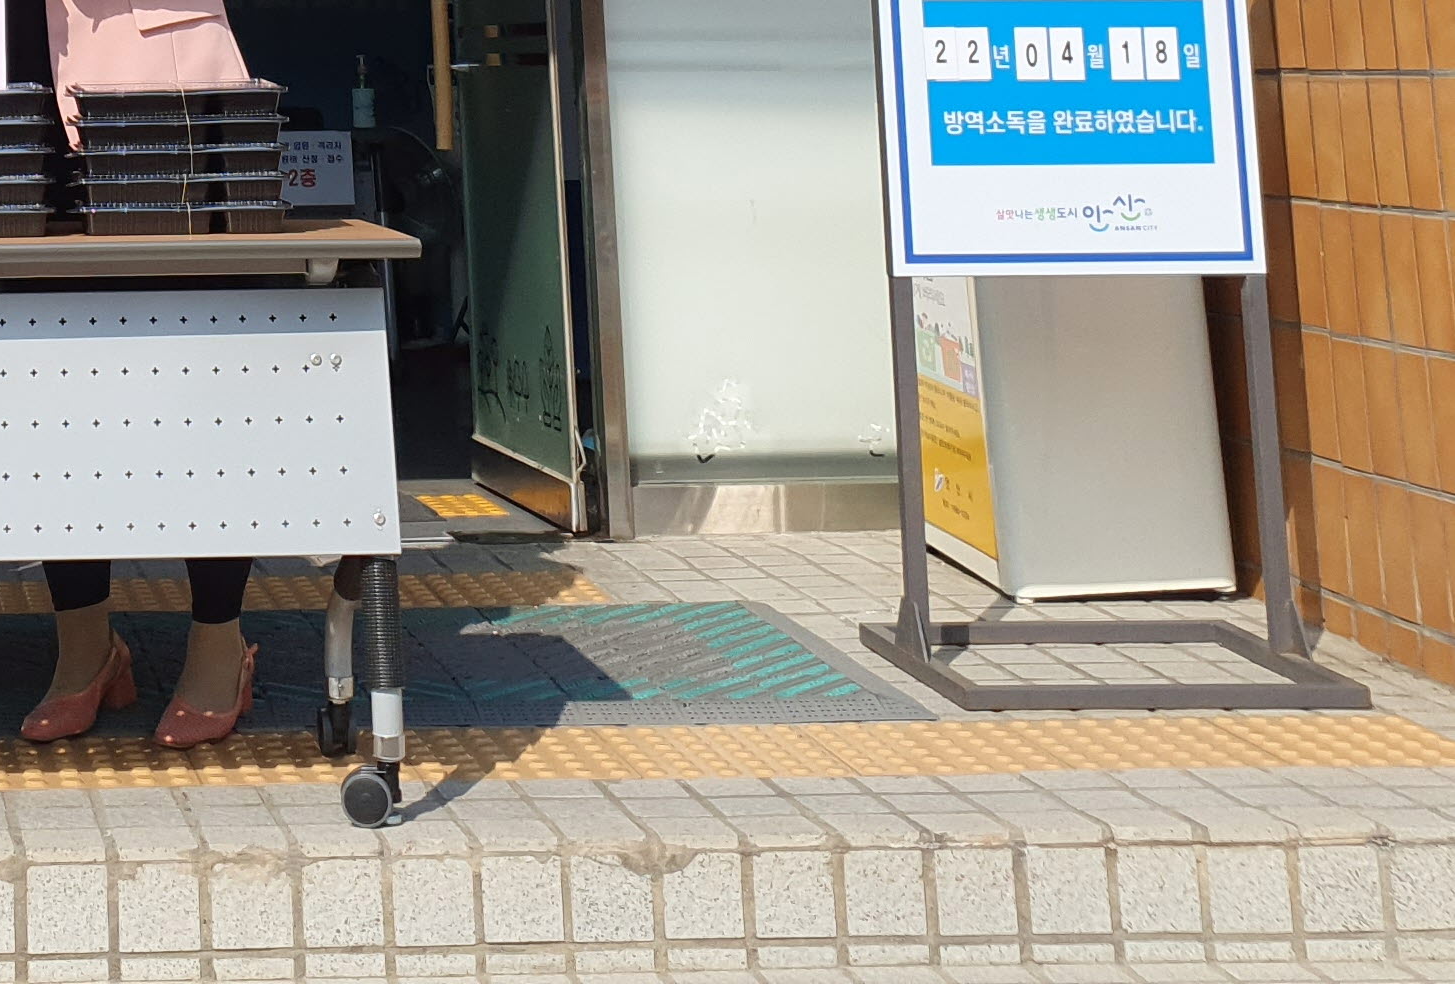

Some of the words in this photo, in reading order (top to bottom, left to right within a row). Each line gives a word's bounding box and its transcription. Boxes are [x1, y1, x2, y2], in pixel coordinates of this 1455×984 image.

[943, 110, 1047, 135] 방역소독을
[1053, 109, 1204, 135] 완료하였습니다.
[288, 169, 317, 188] 2층
[996, 209, 1034, 221] 살맛나는
[1035, 207, 1078, 222] 생생도시
